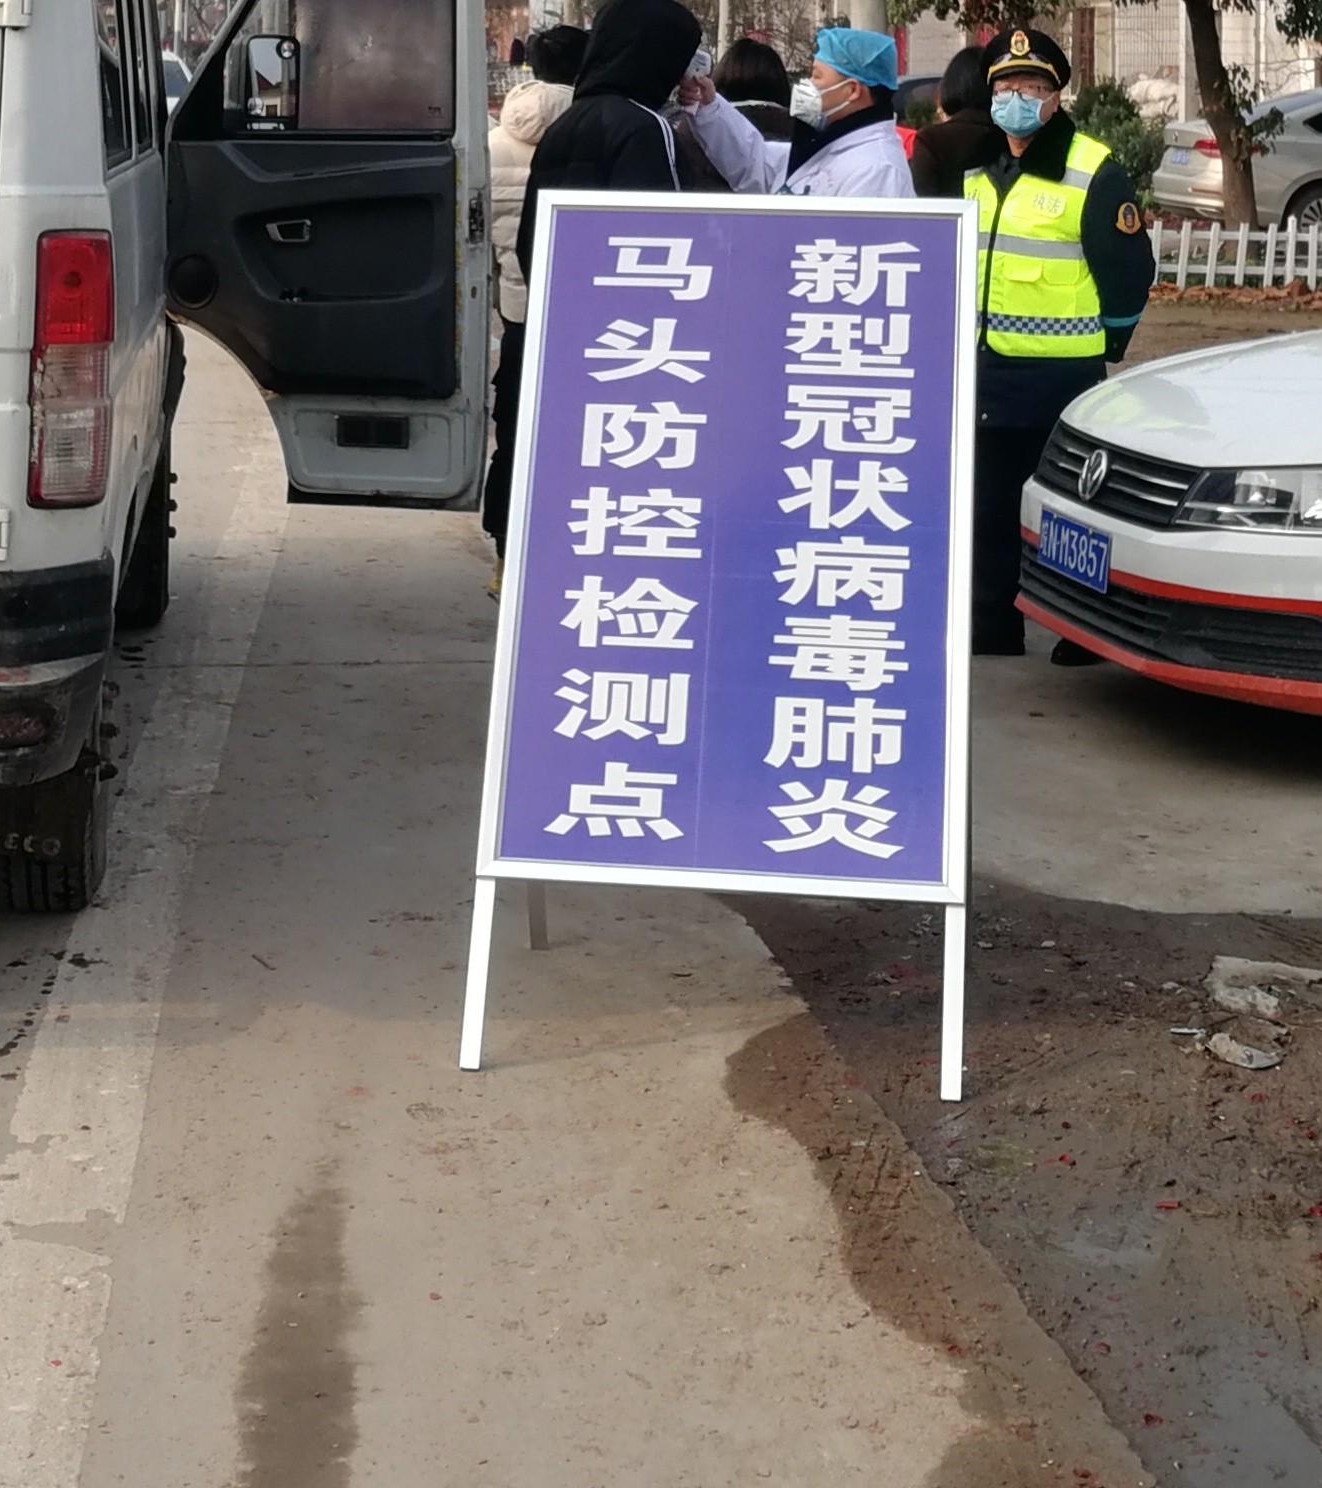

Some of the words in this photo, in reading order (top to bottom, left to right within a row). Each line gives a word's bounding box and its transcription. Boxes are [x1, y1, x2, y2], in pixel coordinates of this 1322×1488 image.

[543, 236, 713, 841] 马头防控检测点
[762, 238, 921, 860] 新型冠状病毒肺炎
